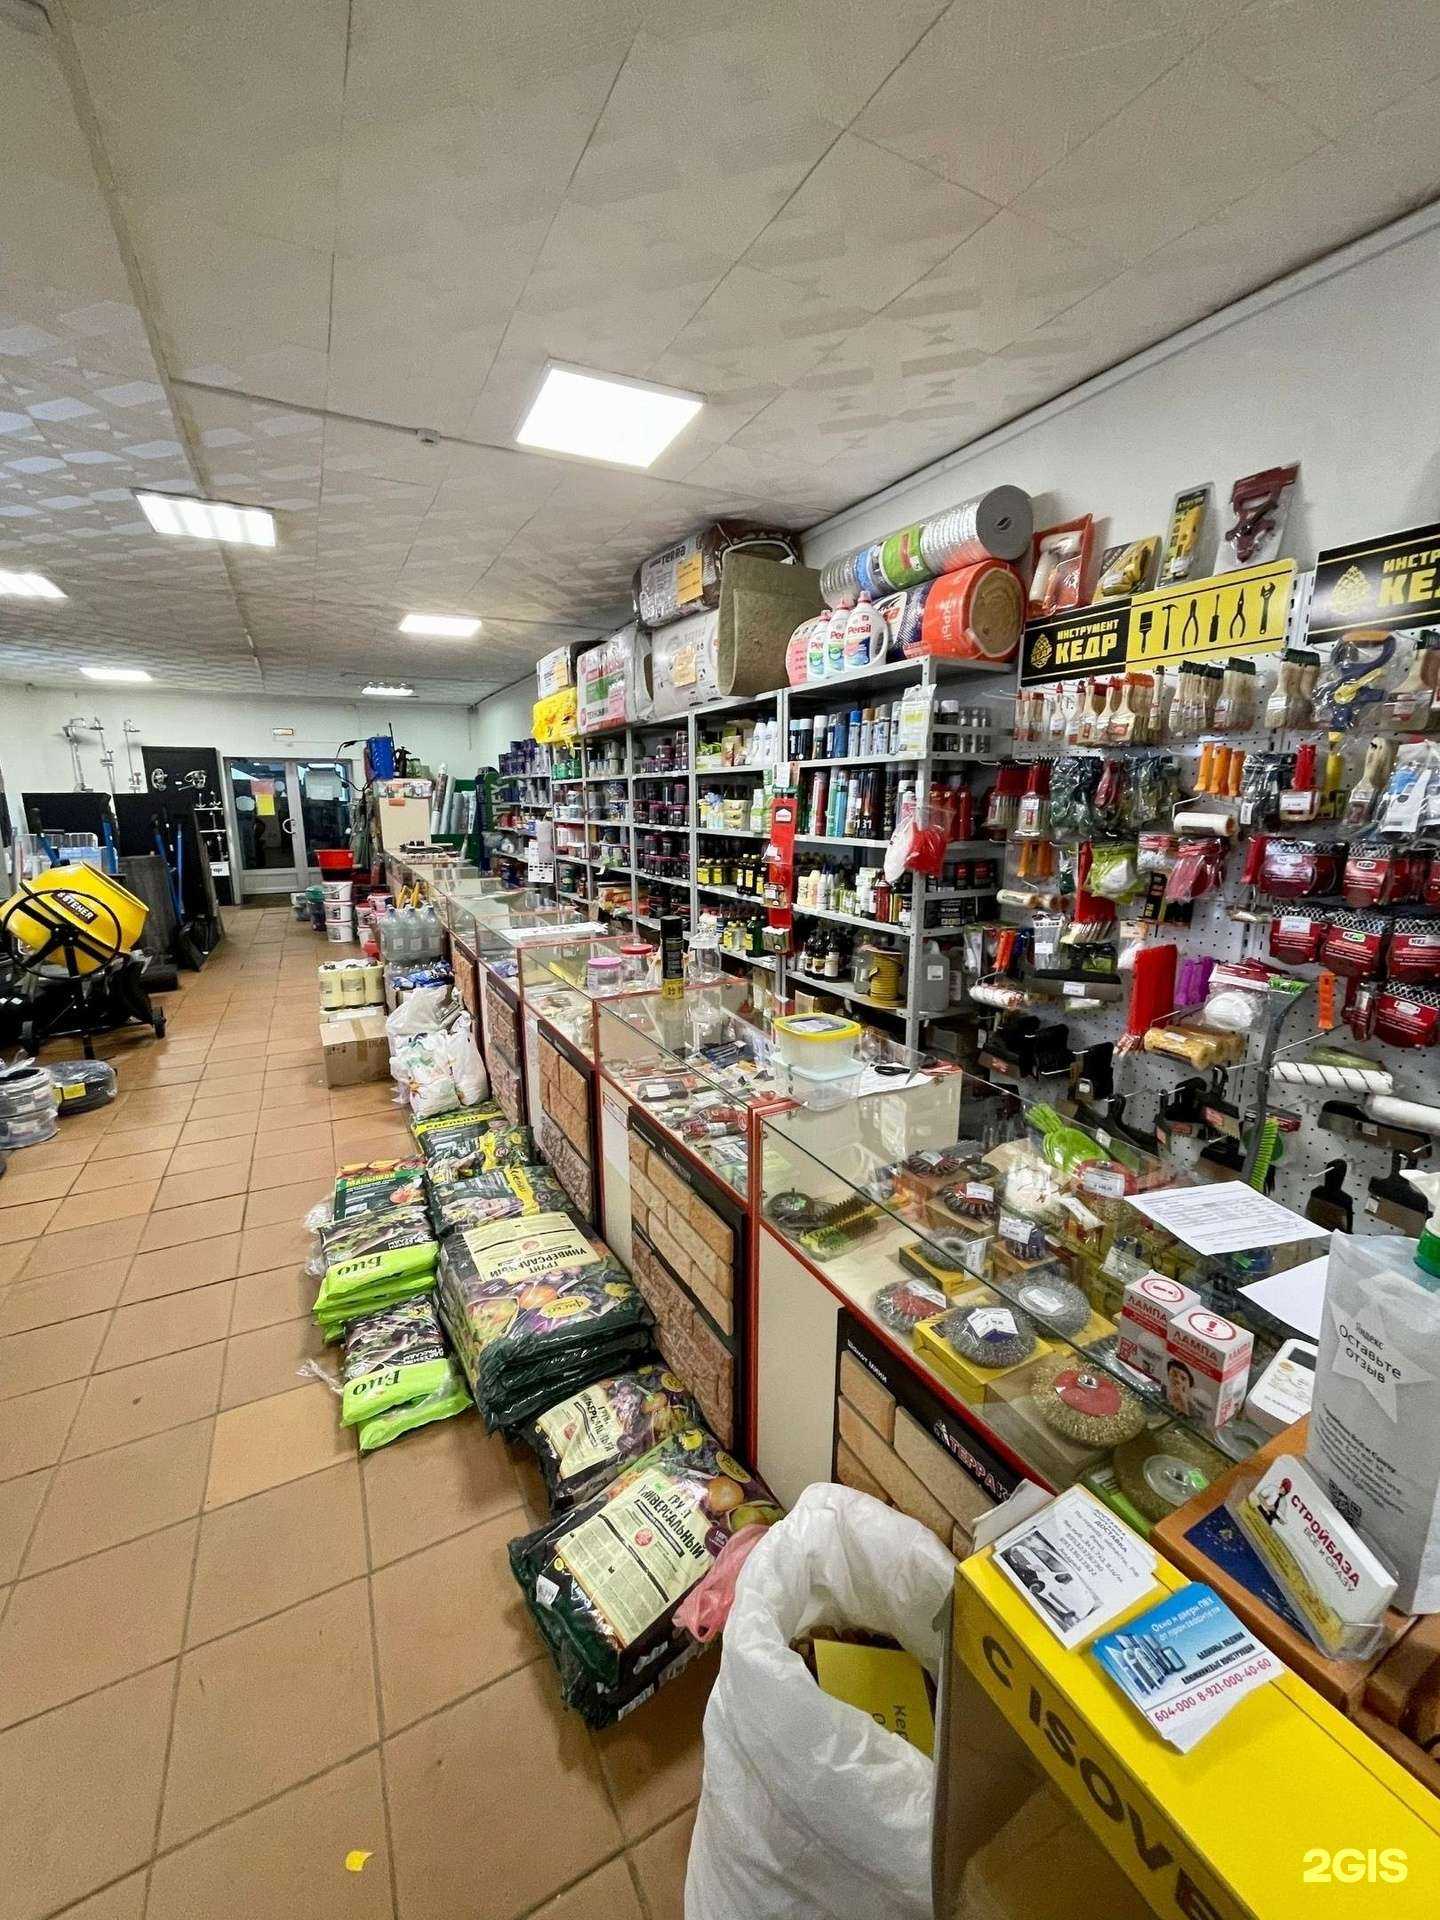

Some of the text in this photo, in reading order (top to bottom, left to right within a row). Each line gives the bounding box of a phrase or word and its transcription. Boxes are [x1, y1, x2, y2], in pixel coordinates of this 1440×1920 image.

[1376, 568, 1440, 608] КЕ
[847, 624, 872, 635] Persil
[1057, 619, 1119, 640] ИНСТРУМЕНТ
[1055, 633, 1117, 665] КЕДР
[530, 1261, 560, 1275] ГРУНТ
[1129, 1296, 1168, 1321] ЛАМПА
[1174, 1331, 1217, 1360] ЛАМПА
[1339, 1325, 1401, 1379] Оставьте
[1356, 1322, 1384, 1350] Яндекс
[1346, 1347, 1386, 1383] отзыв
[669, 1493, 690, 1520] ГРУТ
[1094, 1520, 1127, 1552] ДОСТАВКА
[1291, 1494, 1360, 1587] СТРОЙБАЗА
[1304, 1527, 1318, 1549] ВСЕ
[1325, 1556, 1355, 1592] СРАЗУ
[1154, 1657, 1272, 1722] 604-000 8-921-000-40-60
